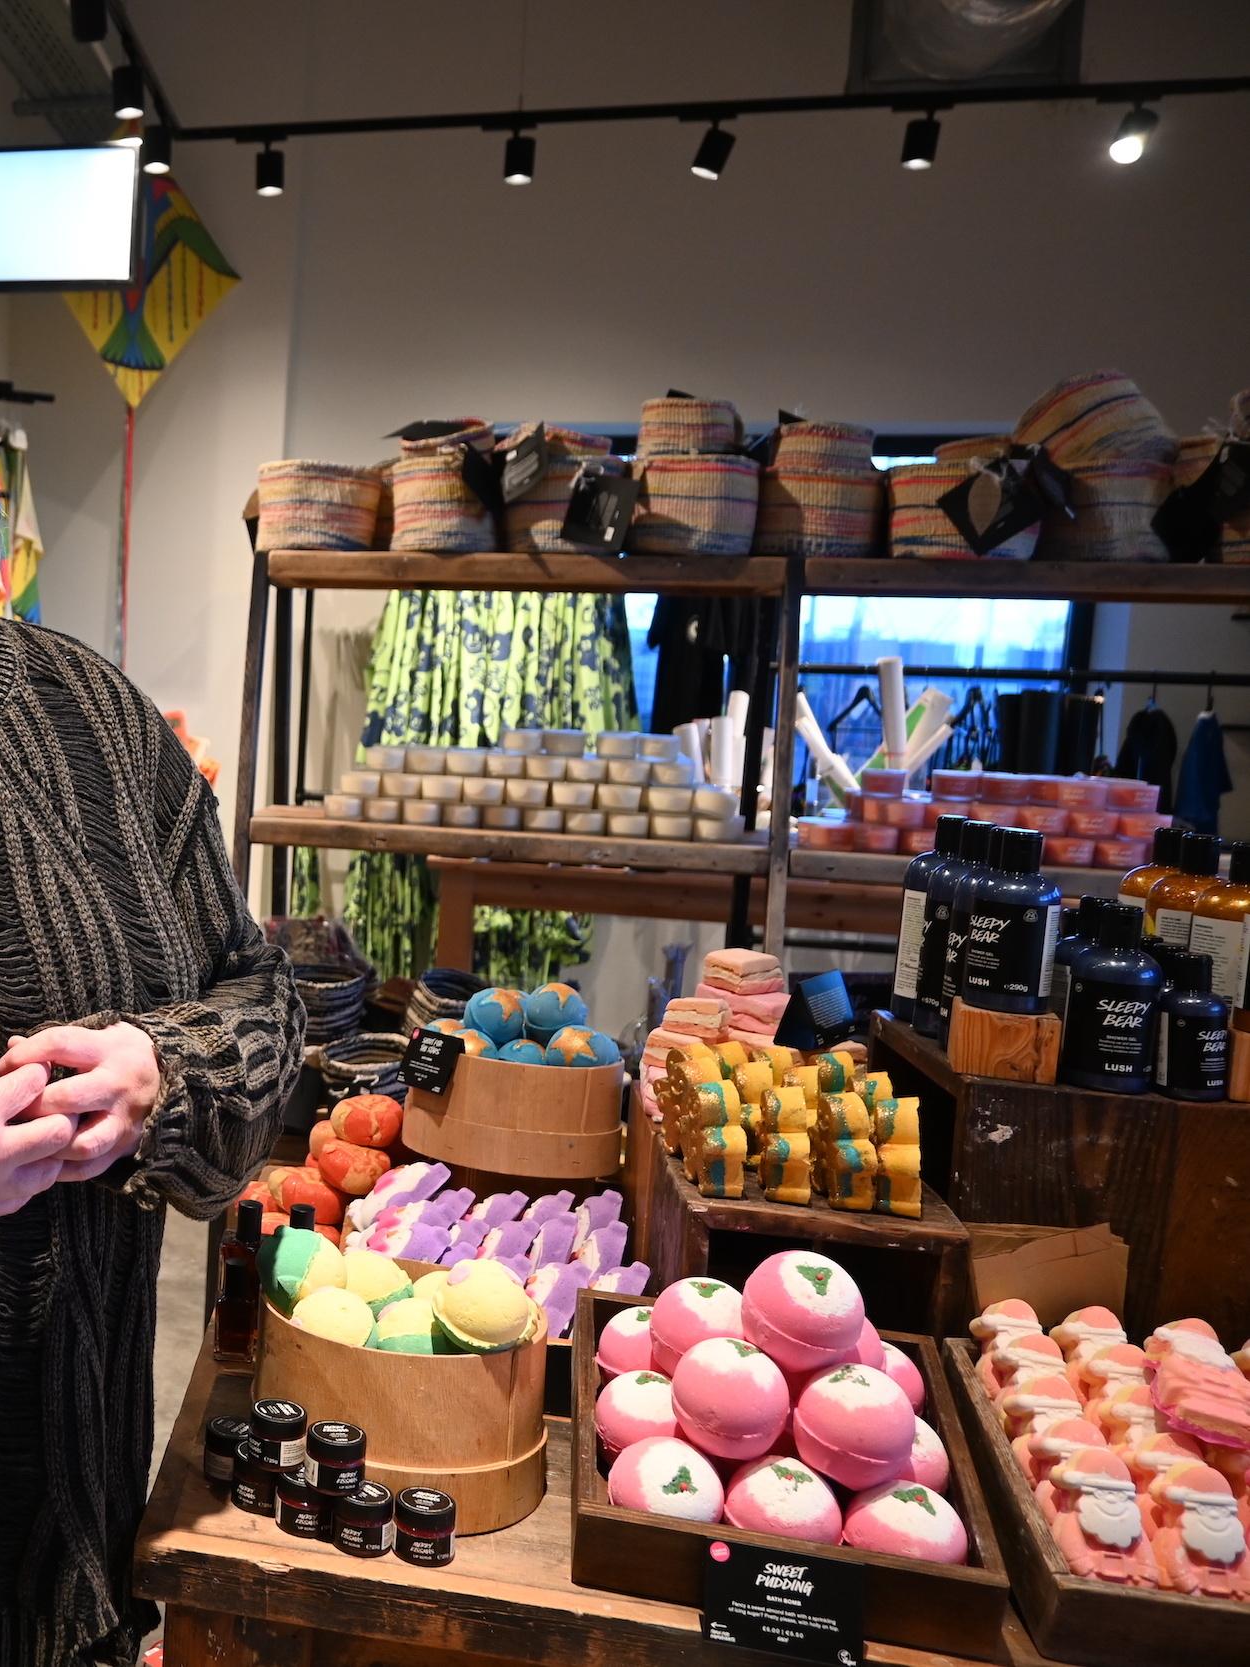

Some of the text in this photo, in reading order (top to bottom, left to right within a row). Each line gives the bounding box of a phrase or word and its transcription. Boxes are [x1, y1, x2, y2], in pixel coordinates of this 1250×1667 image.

[969, 914, 1011, 932] SLEEPY
[970, 928, 1001, 944] BEAR
[968, 975, 990, 987] LUSH
[1096, 999, 1152, 1015] SLEEPY
[1102, 1013, 1144, 1028] BEAR
[1104, 1062, 1133, 1073] LUSH
[1207, 1079, 1224, 1087] LUSH
[763, 1563, 809, 1580] SWEET
[755, 1574, 815, 1597] PUDDING
[766, 1594, 802, 1606] BATH BOMB
